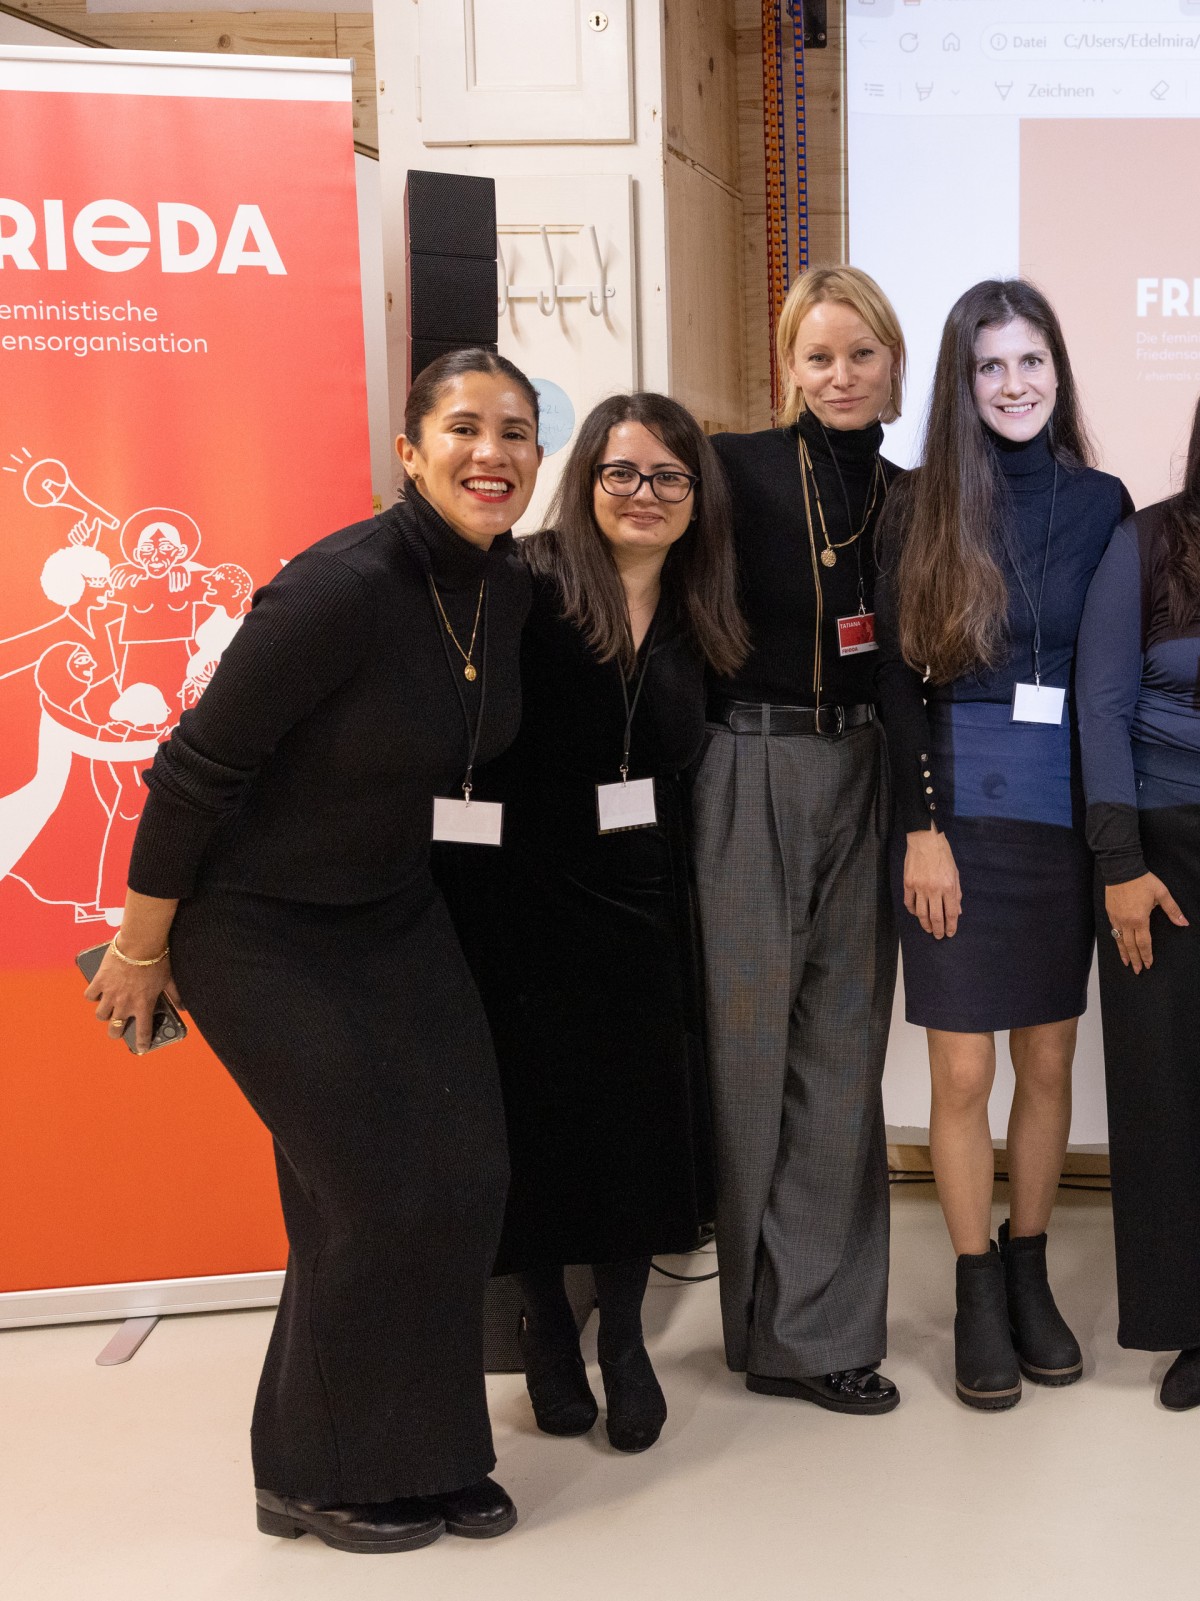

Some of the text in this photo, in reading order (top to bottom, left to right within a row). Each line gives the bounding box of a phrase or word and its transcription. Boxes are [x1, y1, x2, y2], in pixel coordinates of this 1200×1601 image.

[1012, 35, 1048, 49] Datei
[1027, 82, 1096, 98] Zeichnen
[0, 300, 158, 322] eministische
[1, 331, 208, 357] ensorganisation
[1136, 332, 1158, 344] Die
[840, 621, 861, 629] TATIANA
